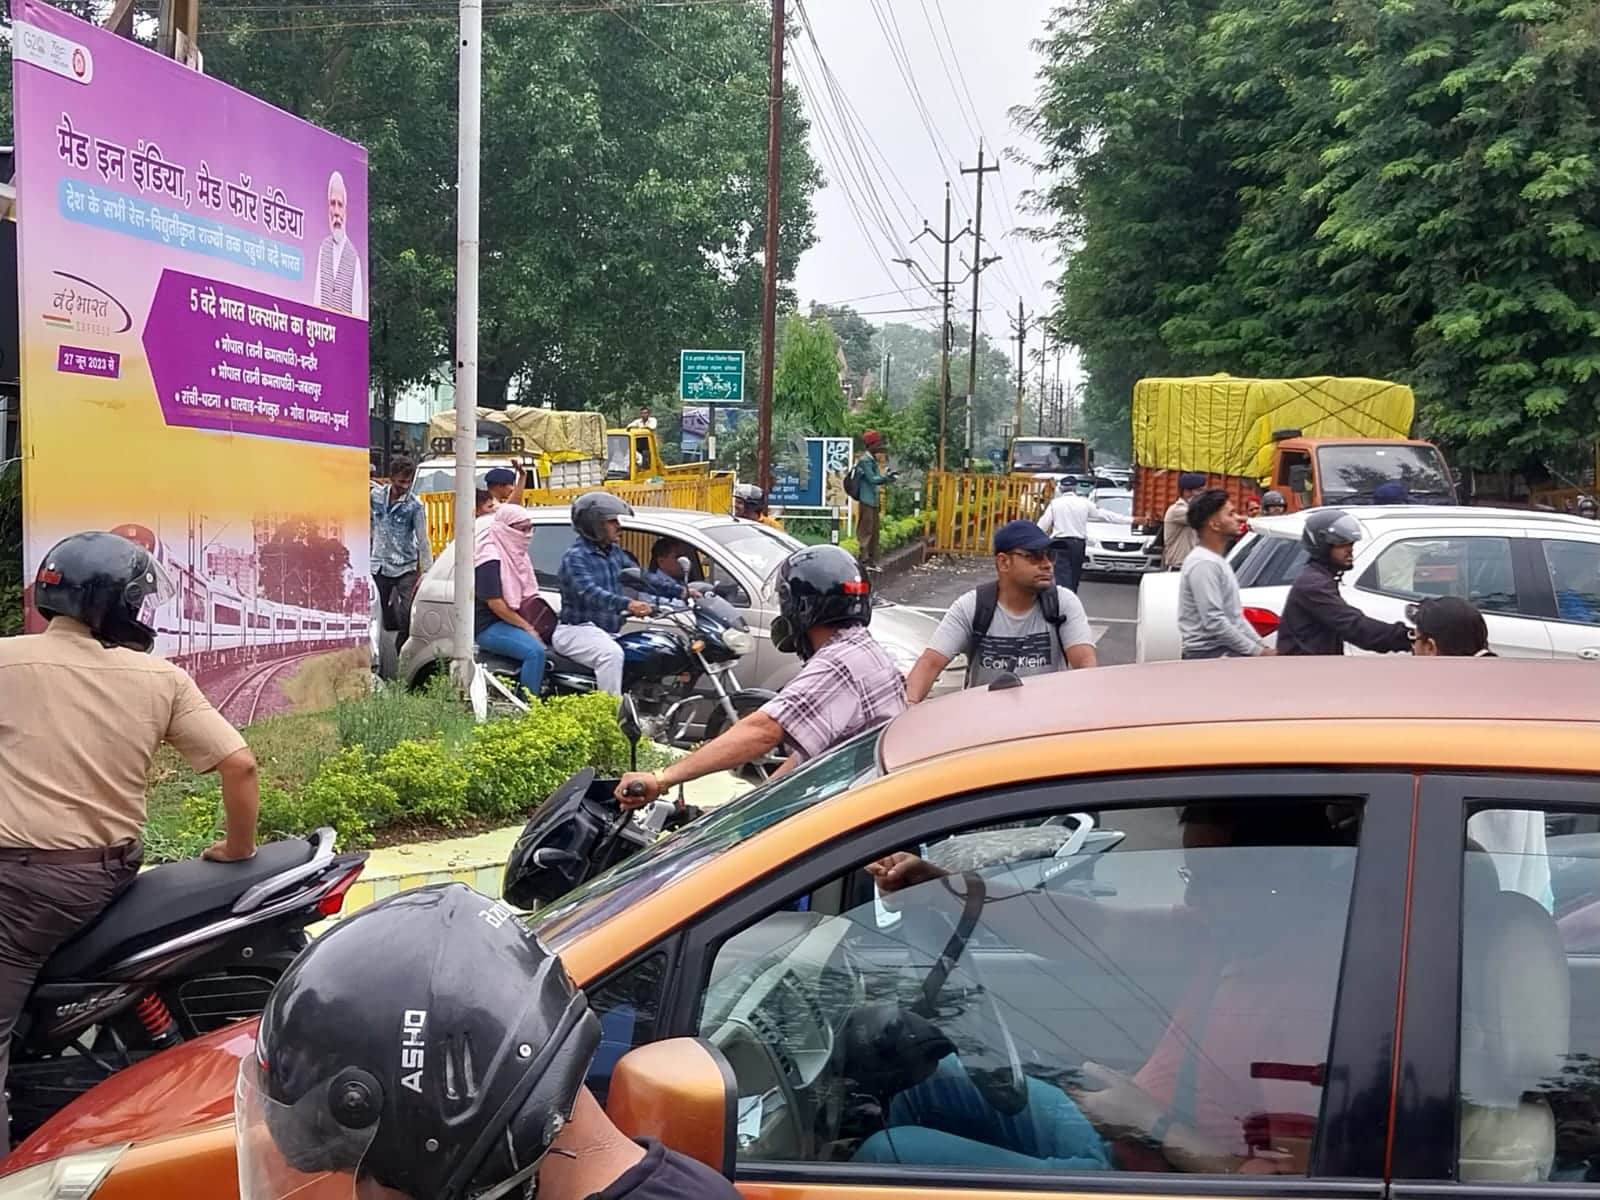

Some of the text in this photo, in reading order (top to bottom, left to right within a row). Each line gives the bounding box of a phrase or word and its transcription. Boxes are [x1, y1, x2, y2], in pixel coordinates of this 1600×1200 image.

[57, 113, 304, 238] मेड इन इंडिया, मेड फॉर इंडिया
[66, 182, 85, 211] देश
[88, 188, 101, 213] के
[103, 197, 126, 222] सभी
[225, 234, 241, 252] तक
[280, 252, 300, 272] भारत
[190, 286, 336, 348] 5 वंदे भारत एक्सप्रेस का शुभारंभ
[221, 332, 244, 355] भोपाल
[63, 353, 73, 366] 27
[88, 356, 106, 370] 2023
[218, 360, 241, 382] भोपाल
[1018, 653, 1047, 669] Klein
